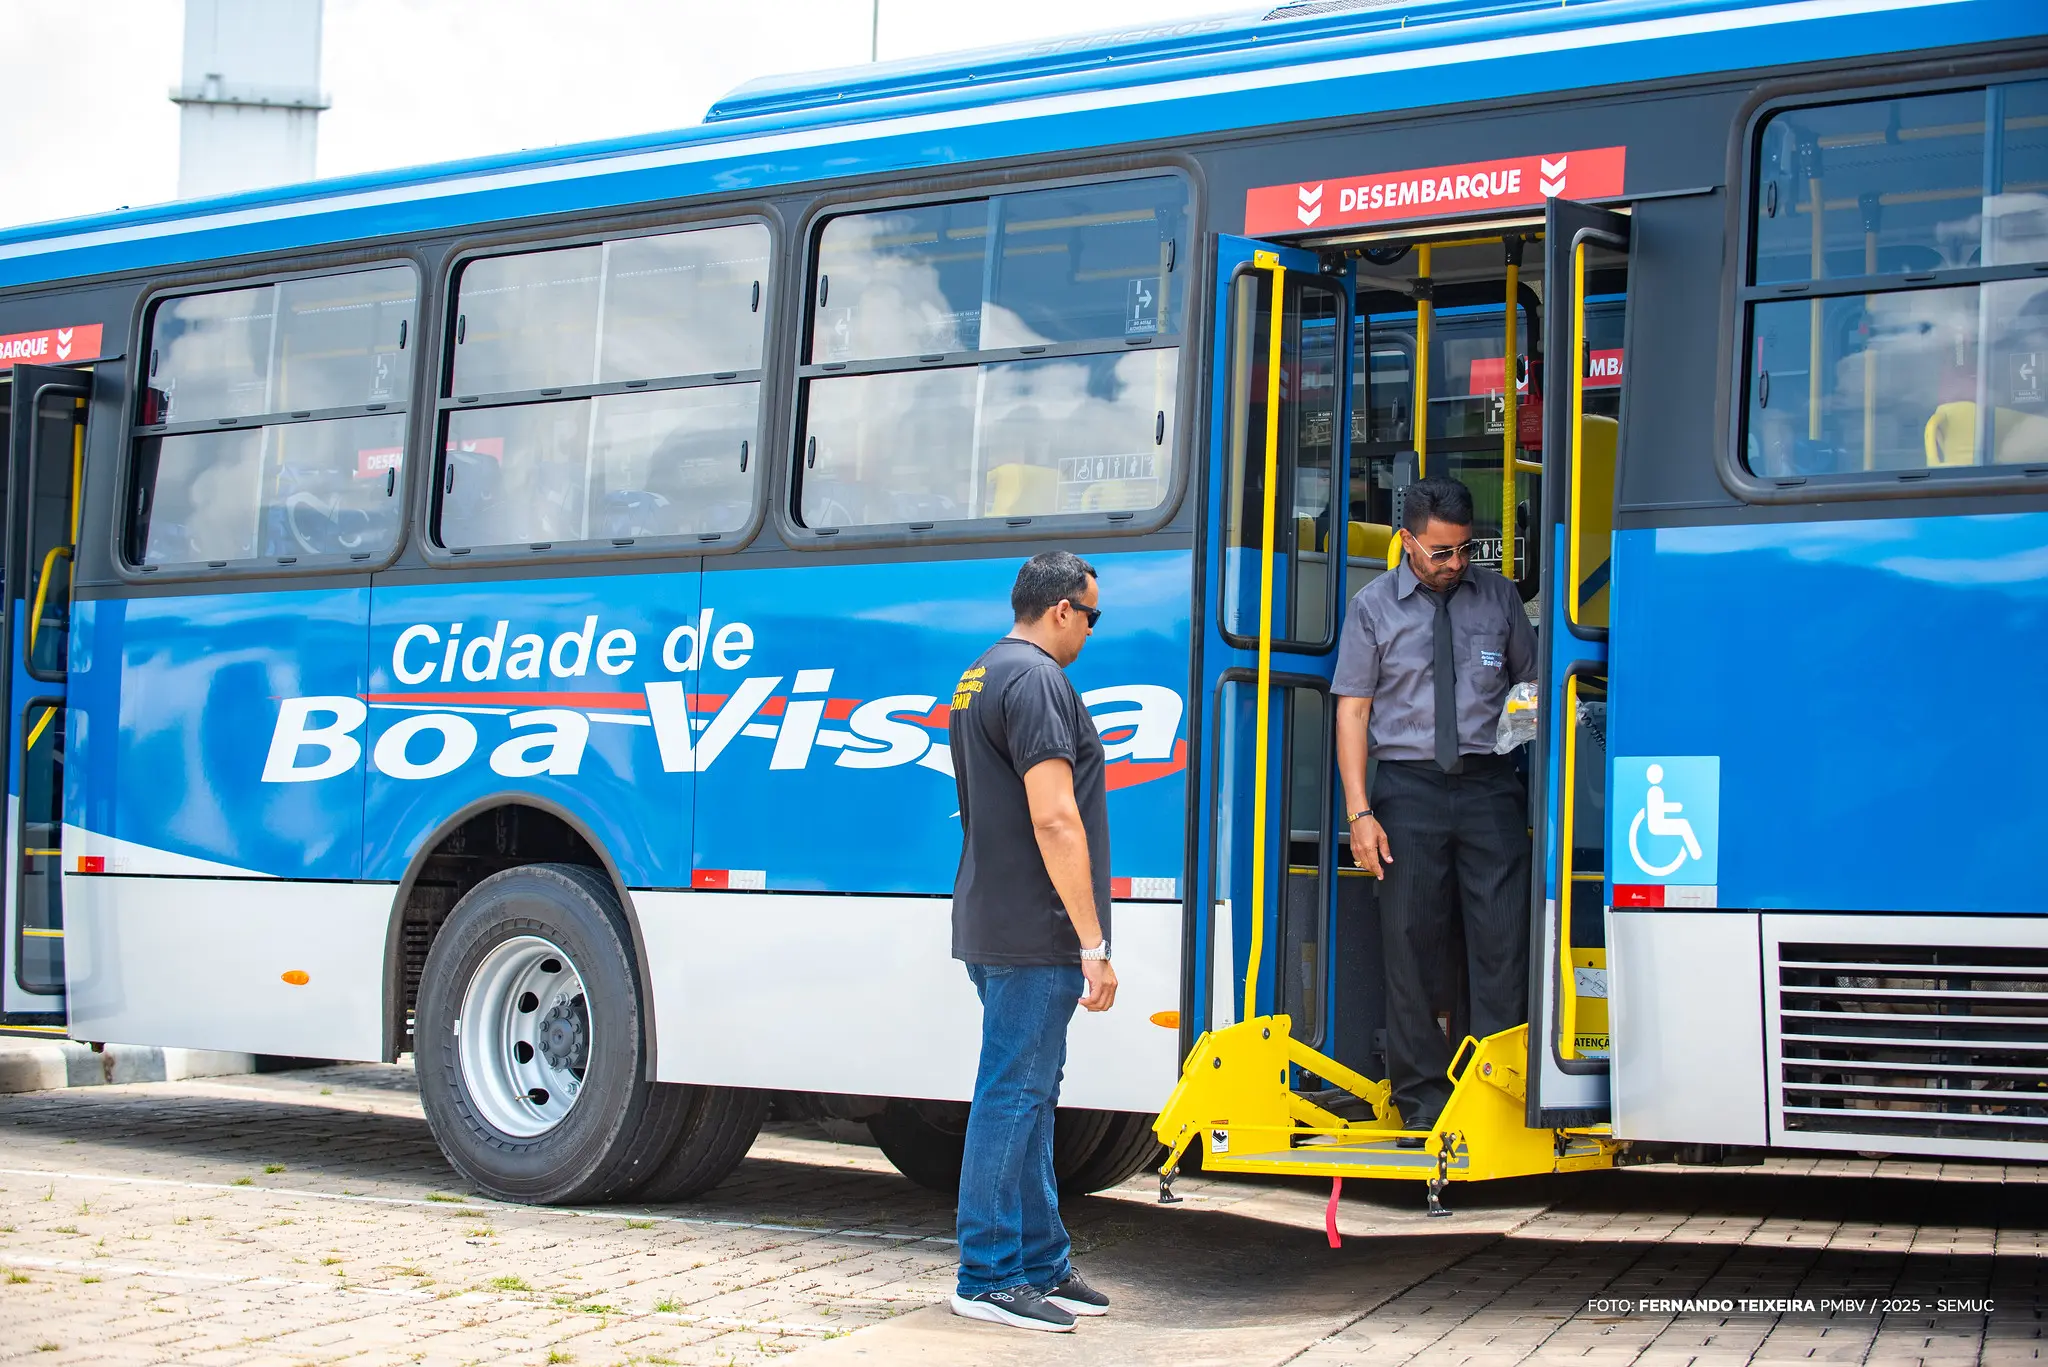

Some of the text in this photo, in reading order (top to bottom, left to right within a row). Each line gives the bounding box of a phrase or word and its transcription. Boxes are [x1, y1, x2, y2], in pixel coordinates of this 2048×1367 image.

[1339, 168, 1521, 212] DESEMBARQUE
[392, 608, 754, 685] Cidade de
[261, 668, 1184, 783] Boa Visa
